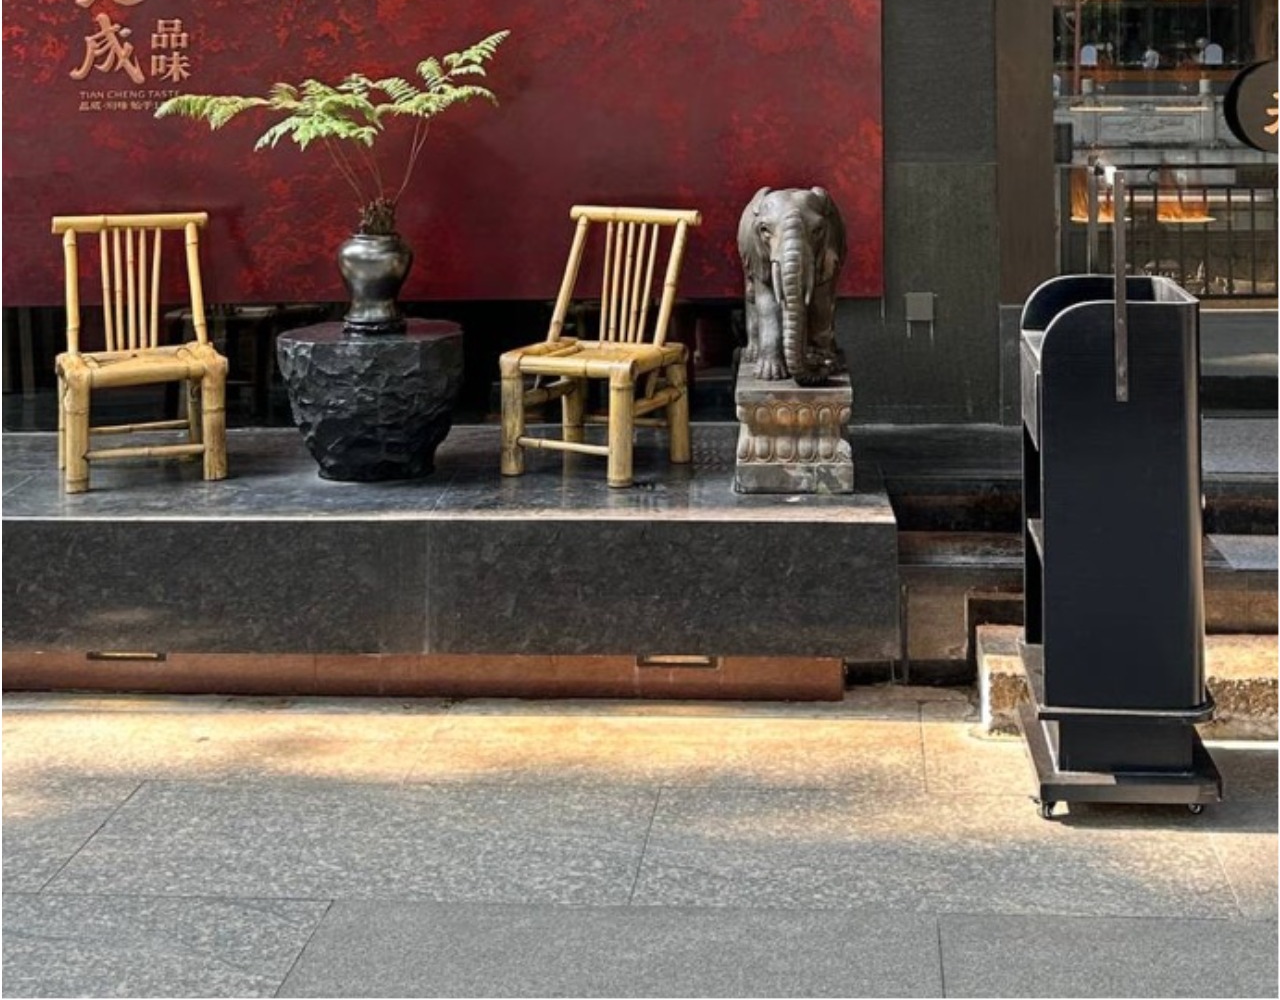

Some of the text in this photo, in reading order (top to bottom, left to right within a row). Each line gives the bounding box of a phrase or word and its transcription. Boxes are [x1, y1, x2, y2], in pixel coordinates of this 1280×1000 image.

[151, 18, 191, 83] 品味
[79, 90, 104, 100] TIAN
[107, 90, 145, 100] CHENG
